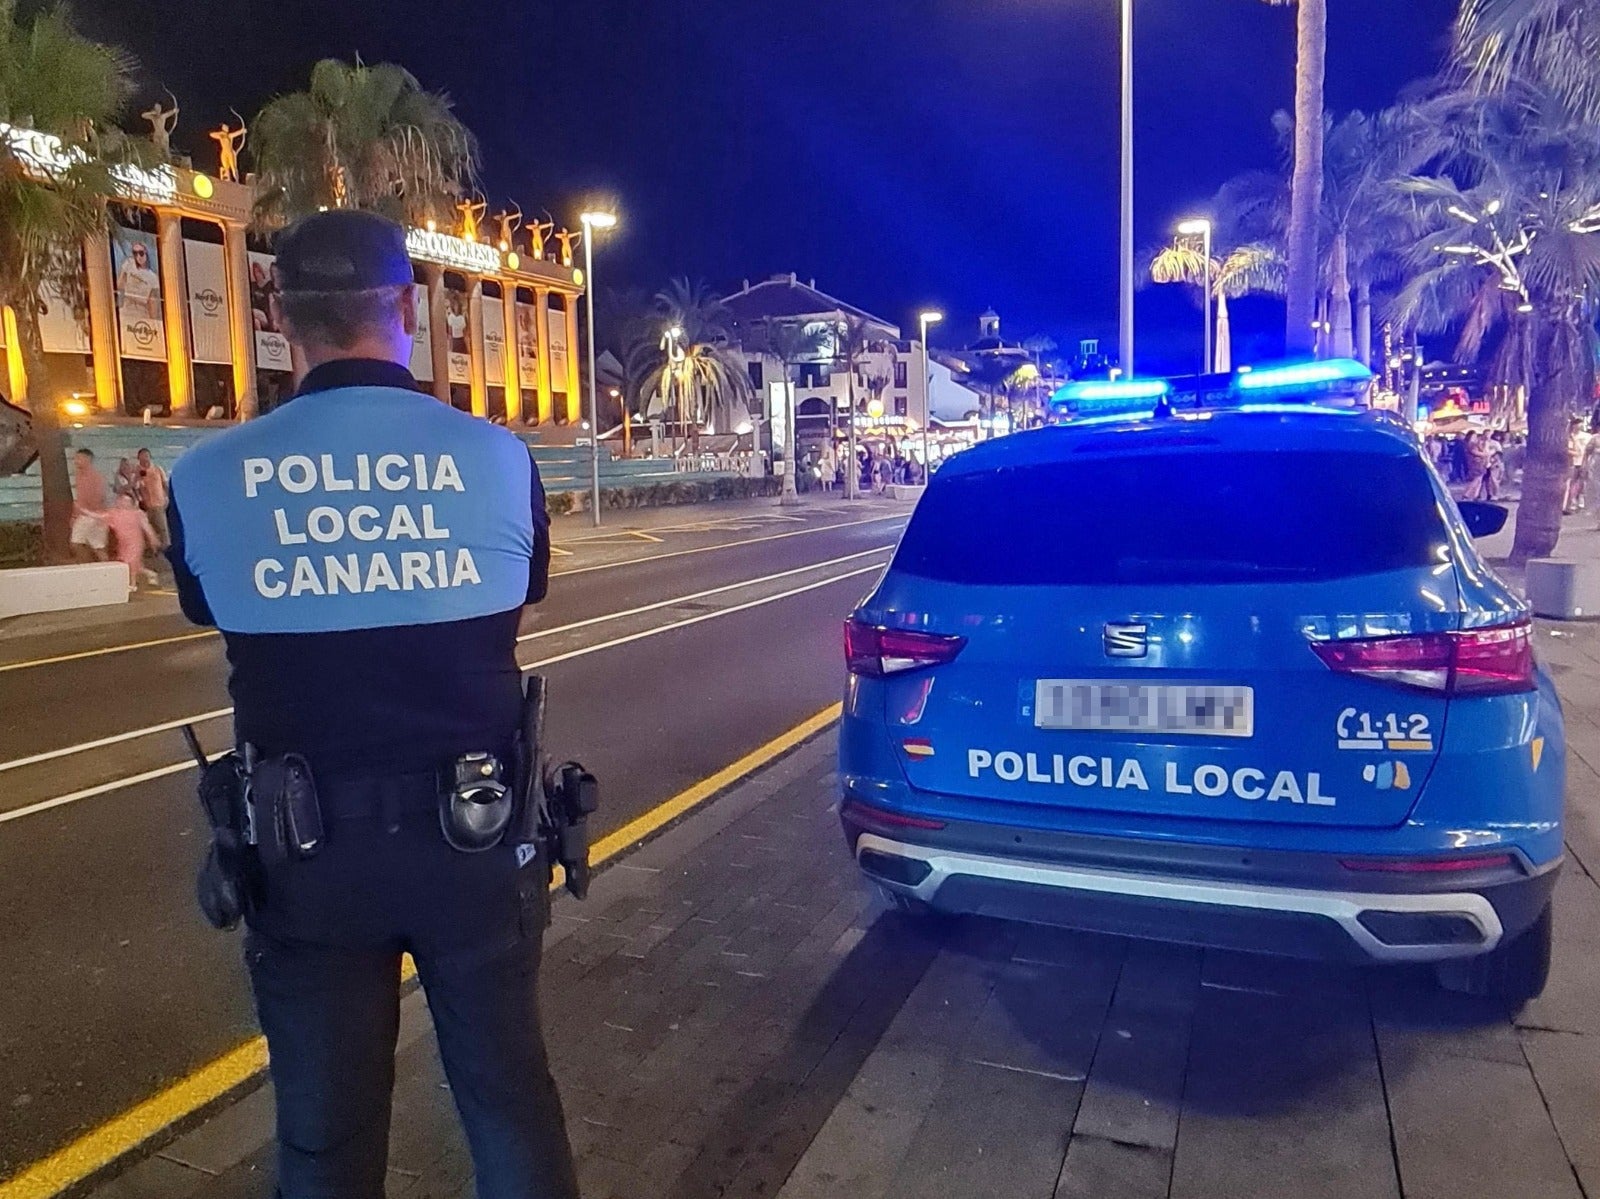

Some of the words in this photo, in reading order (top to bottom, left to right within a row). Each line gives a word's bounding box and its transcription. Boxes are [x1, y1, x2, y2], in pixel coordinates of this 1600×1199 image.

[243, 453, 466, 498] POLICIA
[274, 503, 450, 545] LOCAL
[254, 547, 482, 599] CANARIA
[967, 748, 1150, 791] POLICIA
[1165, 761, 1337, 807] LOCAL
